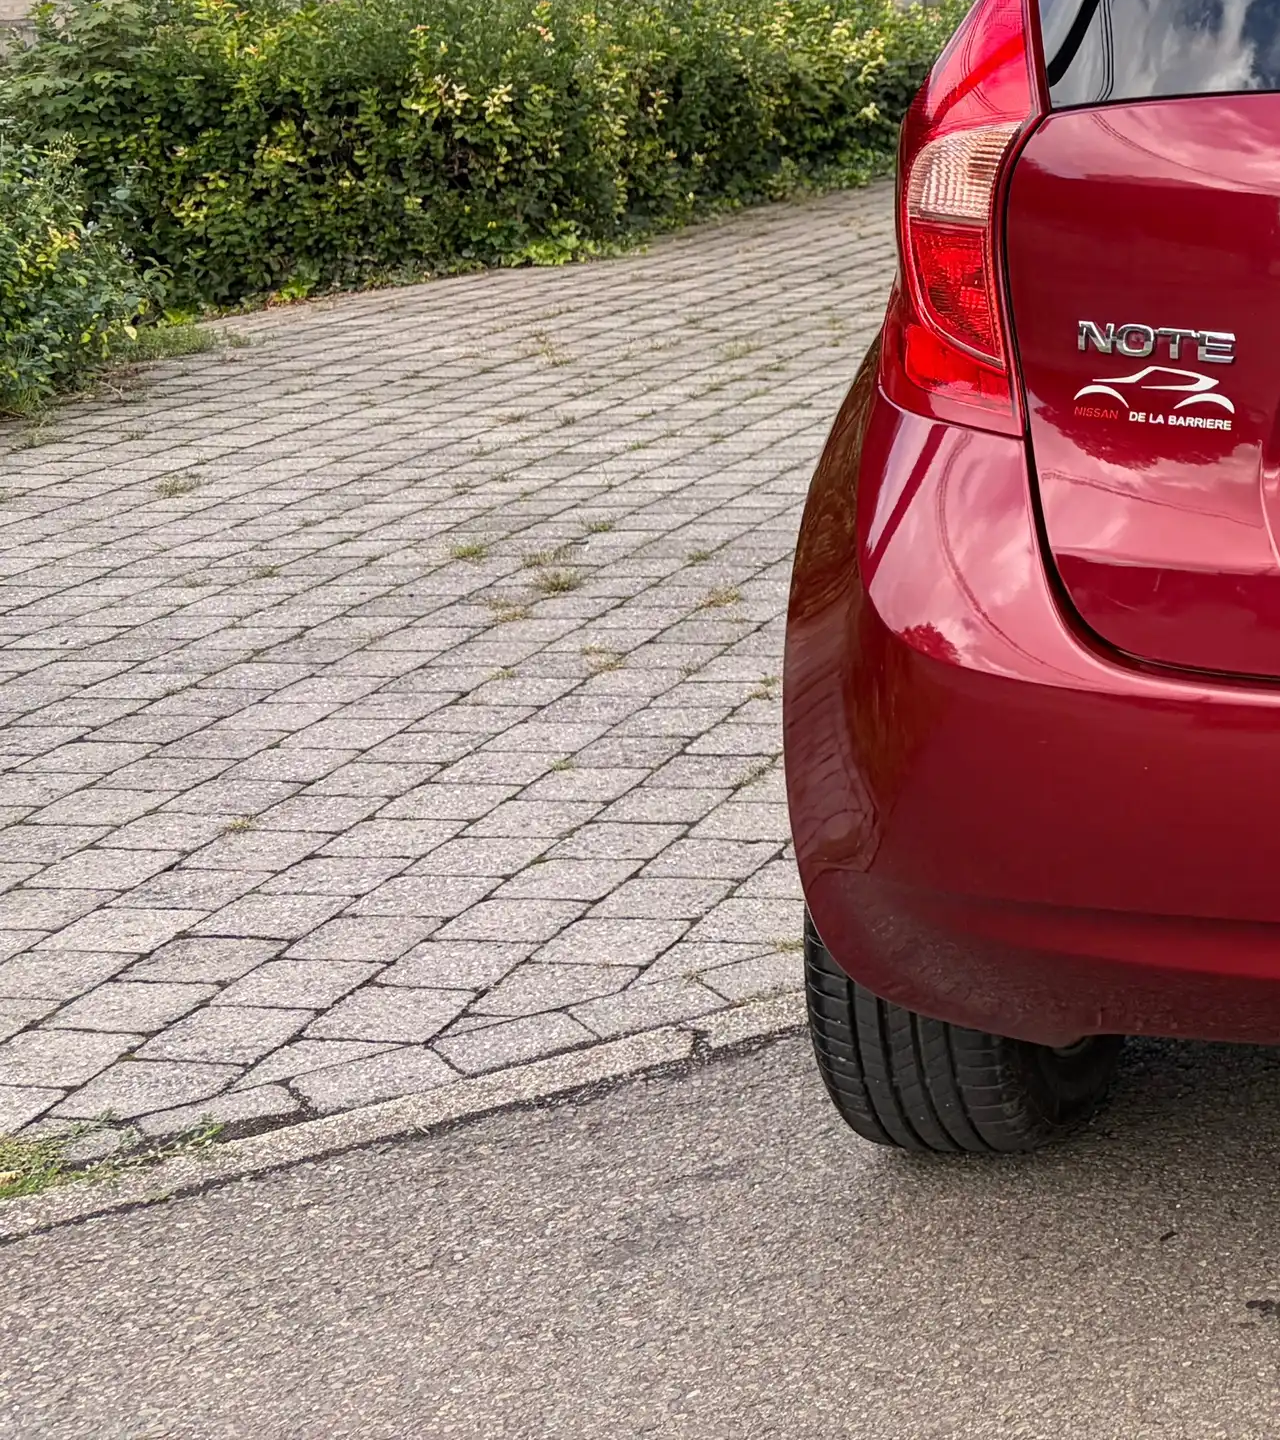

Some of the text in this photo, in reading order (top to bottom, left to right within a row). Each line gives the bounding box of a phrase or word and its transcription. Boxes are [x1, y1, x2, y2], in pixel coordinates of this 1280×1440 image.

[1077, 320, 1237, 364] NOTE
[1073, 406, 1232, 431] NISSAN DE LA BARRIERE
